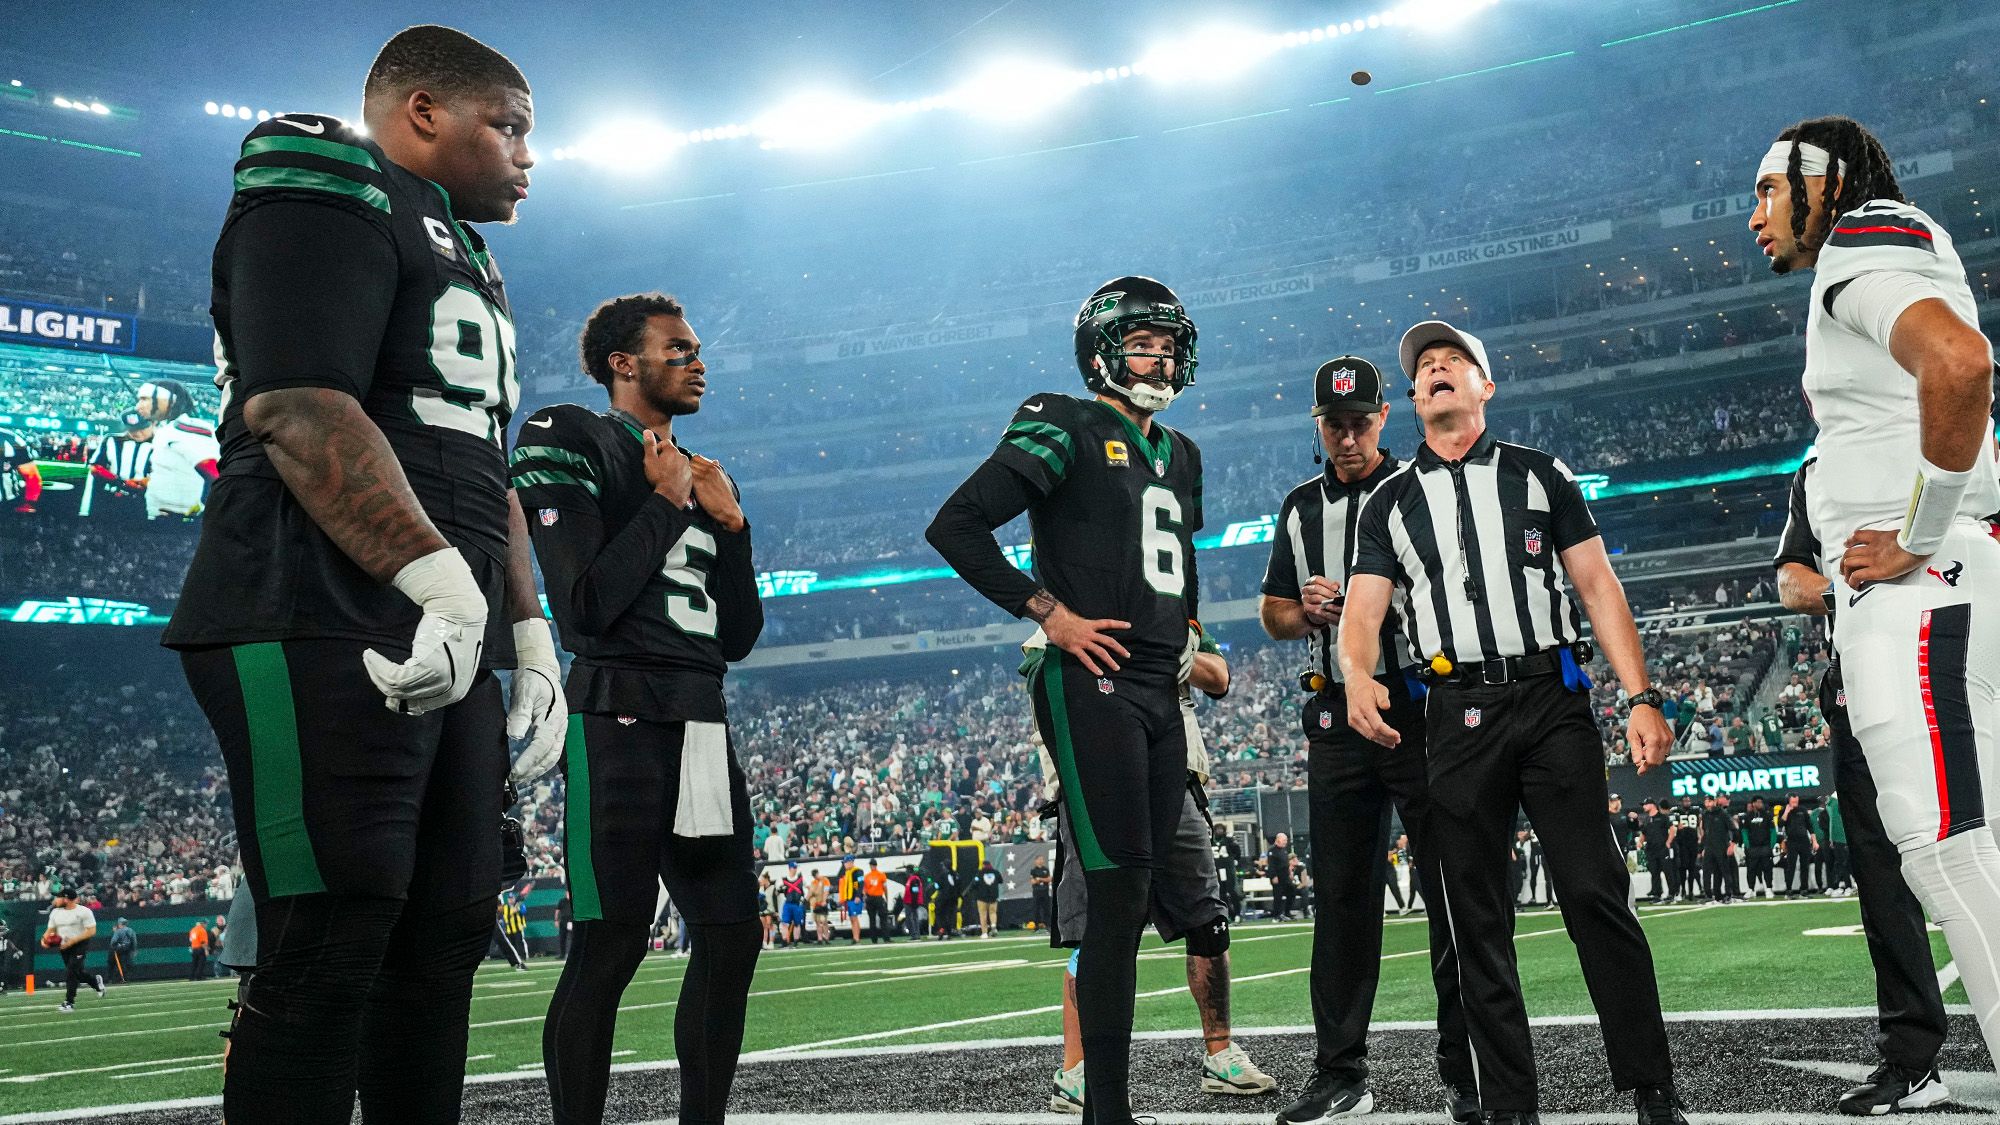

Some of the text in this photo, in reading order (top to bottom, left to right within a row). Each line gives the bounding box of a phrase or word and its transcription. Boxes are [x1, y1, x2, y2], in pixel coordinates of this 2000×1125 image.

[1691, 198, 1726, 220] 60
[423, 216, 453, 250] C
[1389, 256, 1421, 276] 99
[1428, 247, 1480, 268] MARK
[1483, 229, 1580, 258] GASTINEAU
[1230, 278, 1311, 301] FERGUSON
[0, 306, 122, 344] LIGHT
[837, 325, 995, 358] 80 WAYNE CHREBET
[1334, 378, 1353, 392] NFL
[1106, 440, 1128, 461] C
[1141, 483, 1185, 598] 6
[1527, 540, 1541, 552] NFL
[661, 524, 718, 638] 5
[936, 633, 976, 646] MetLife
[1672, 764, 1821, 798] st QUARTER
